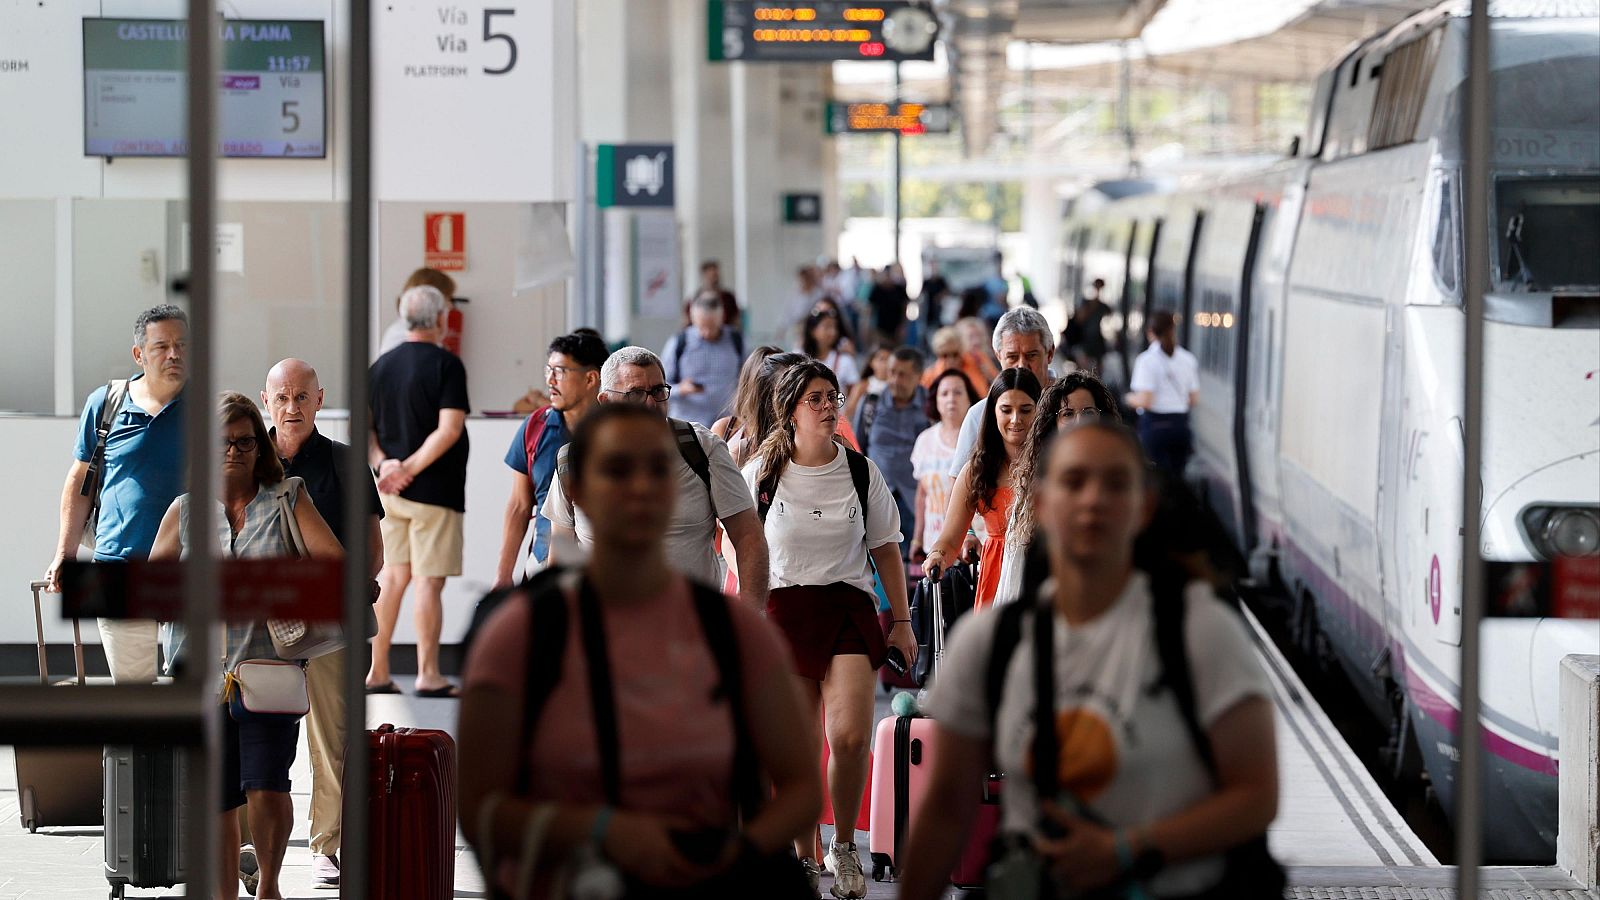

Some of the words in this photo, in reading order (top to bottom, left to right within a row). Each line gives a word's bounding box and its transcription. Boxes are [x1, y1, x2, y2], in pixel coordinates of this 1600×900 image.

[437, 5, 468, 25] Vía
[239, 24, 292, 41] PLANA
[436, 34, 467, 52] Via
[482, 8, 517, 75] 5
[0, 59, 29, 73] ORM
[268, 56, 310, 71] 11:57
[404, 65, 468, 77] PLATFORM
[282, 101, 300, 133] 5
